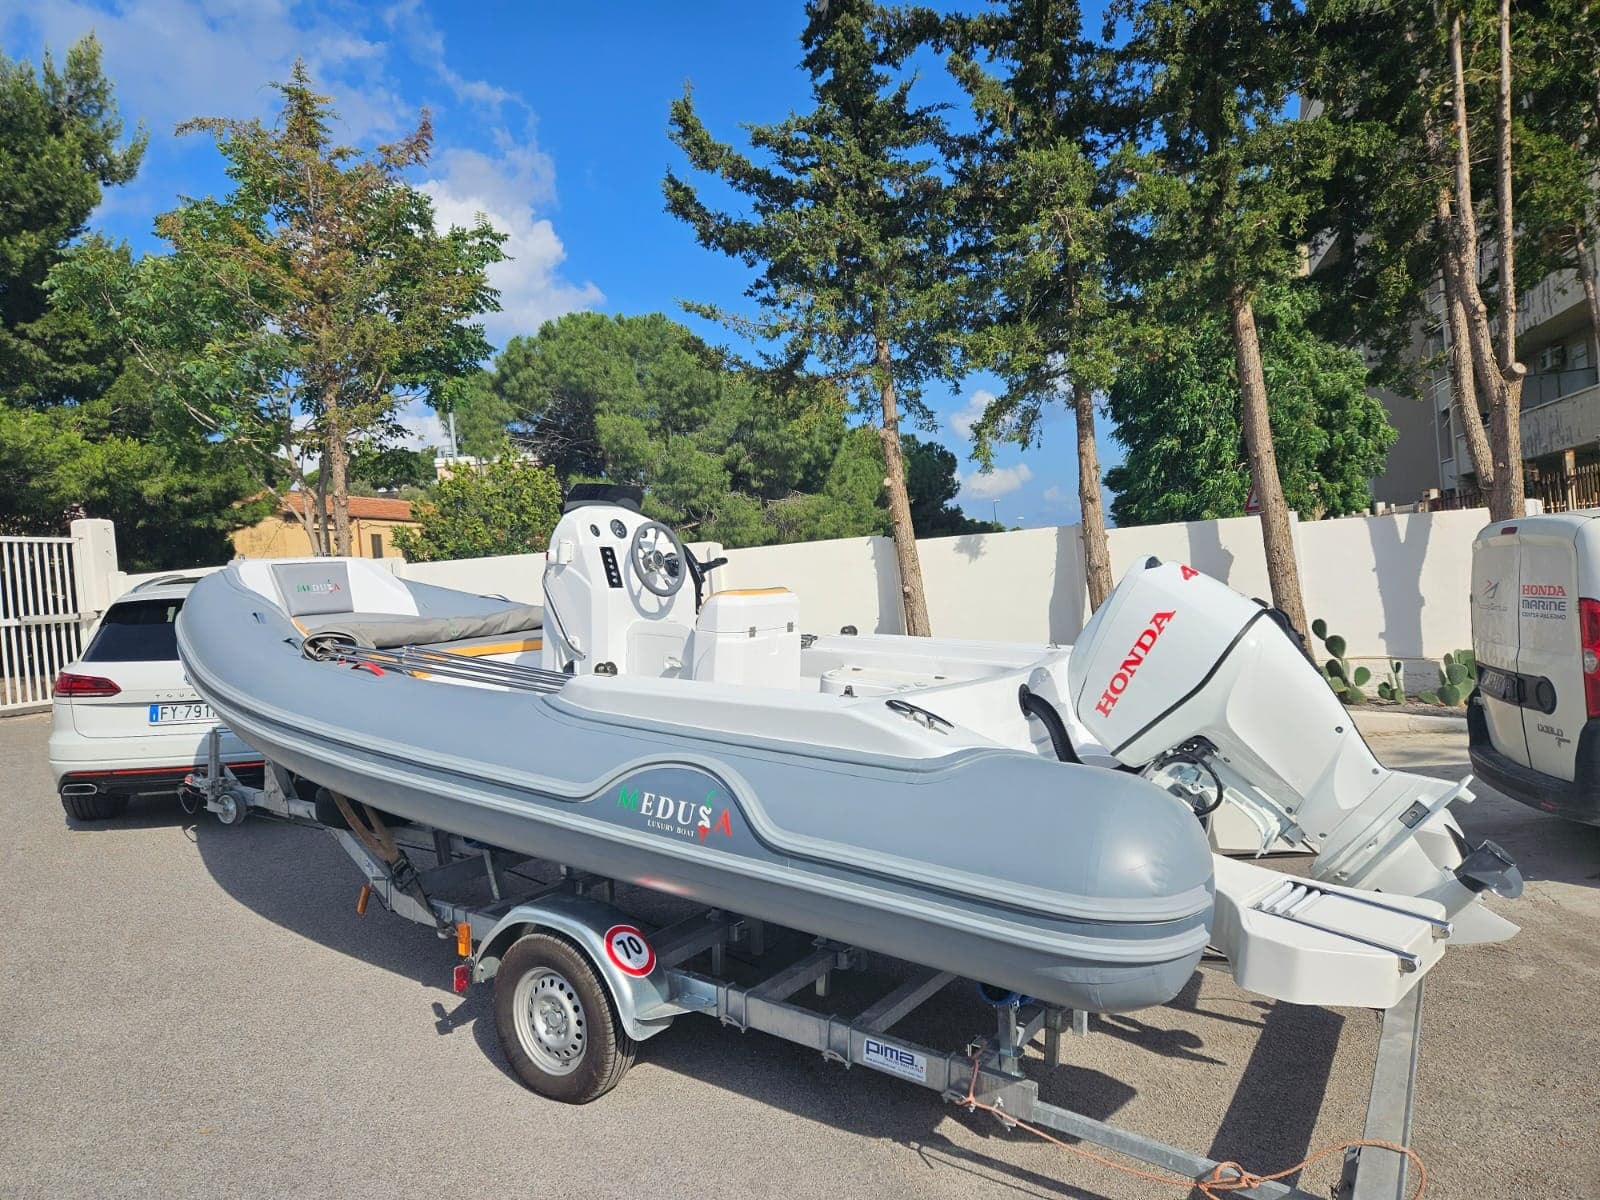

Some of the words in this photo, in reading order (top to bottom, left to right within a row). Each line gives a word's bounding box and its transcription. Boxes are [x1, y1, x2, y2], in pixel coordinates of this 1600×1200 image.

[1521, 584, 1567, 597] HONDA
[1521, 599, 1567, 612] MARINE
[1095, 610, 1177, 718] HONDA
[161, 705, 178, 720] FY
[184, 704, 217, 719] 791
[616, 783, 733, 844] MEDUSA
[647, 818, 674, 833] LUXURY
[676, 826, 695, 838] BOAT
[616, 935, 643, 960] 70
